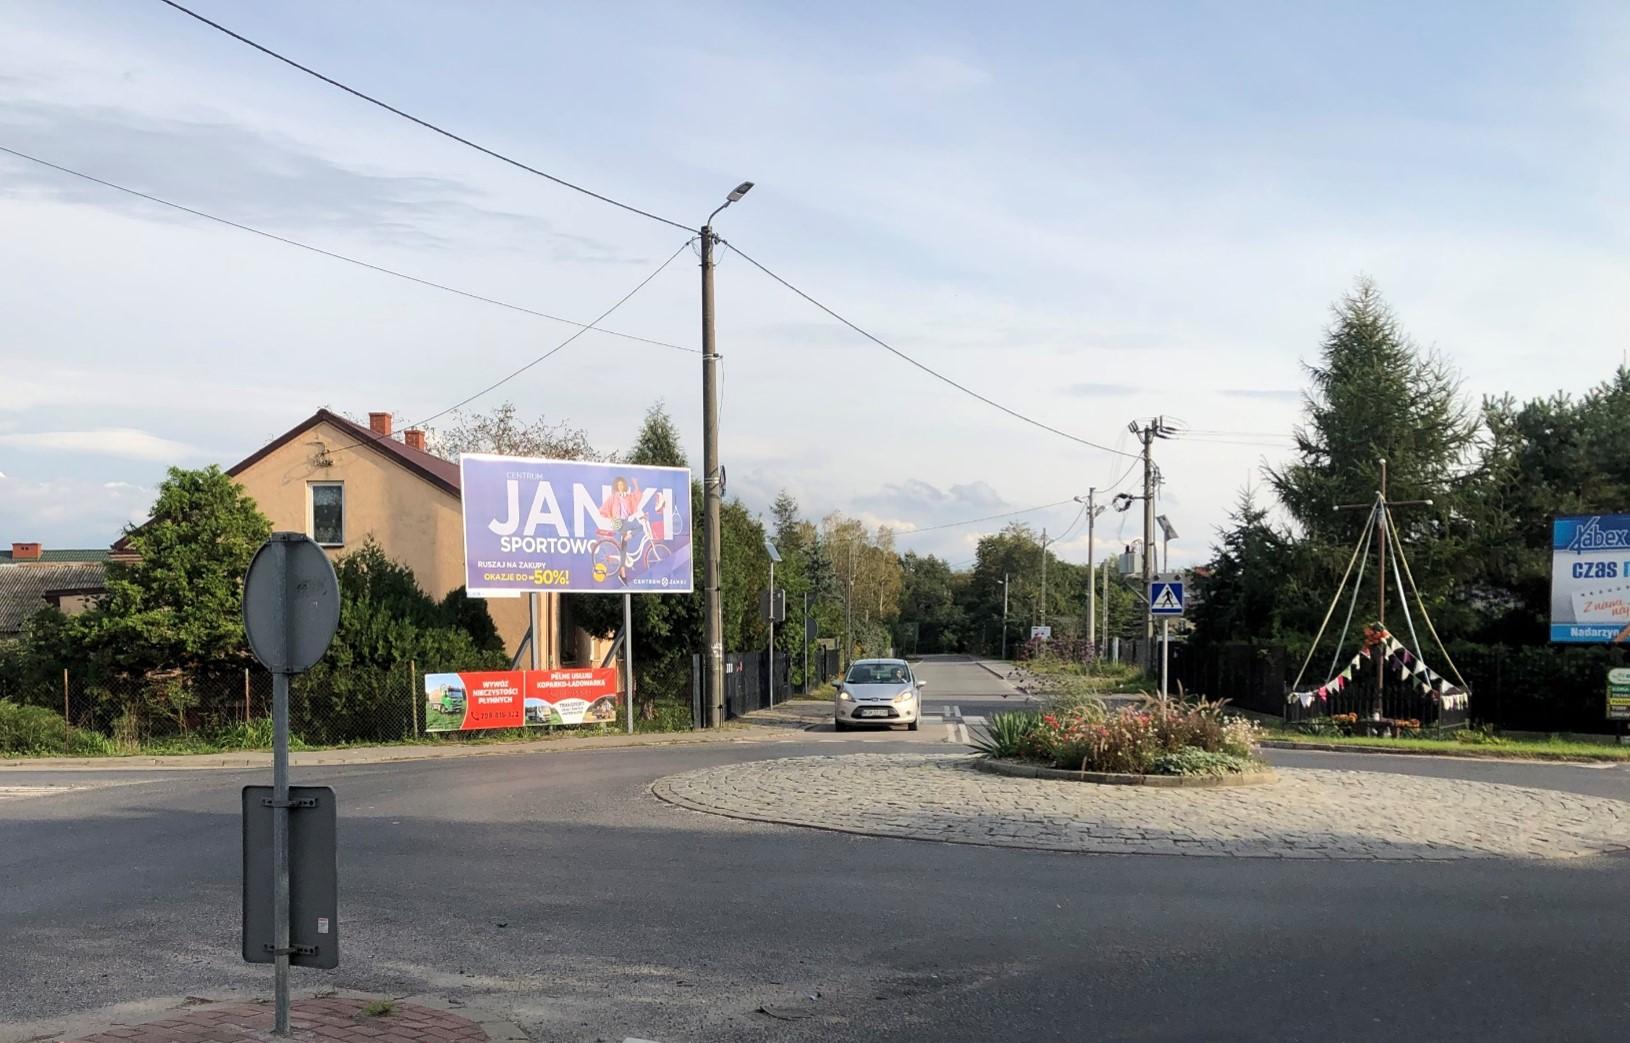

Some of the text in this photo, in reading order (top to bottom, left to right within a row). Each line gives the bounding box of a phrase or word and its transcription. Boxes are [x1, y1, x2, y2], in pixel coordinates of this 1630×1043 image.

[506, 471, 544, 480] CENTRUM
[477, 560, 546, 569] RUSZAJ NA ZAKUPY
[1572, 561, 1618, 579] czas
[484, 573, 514, 581] OKAZJE
[516, 573, 528, 581] DO
